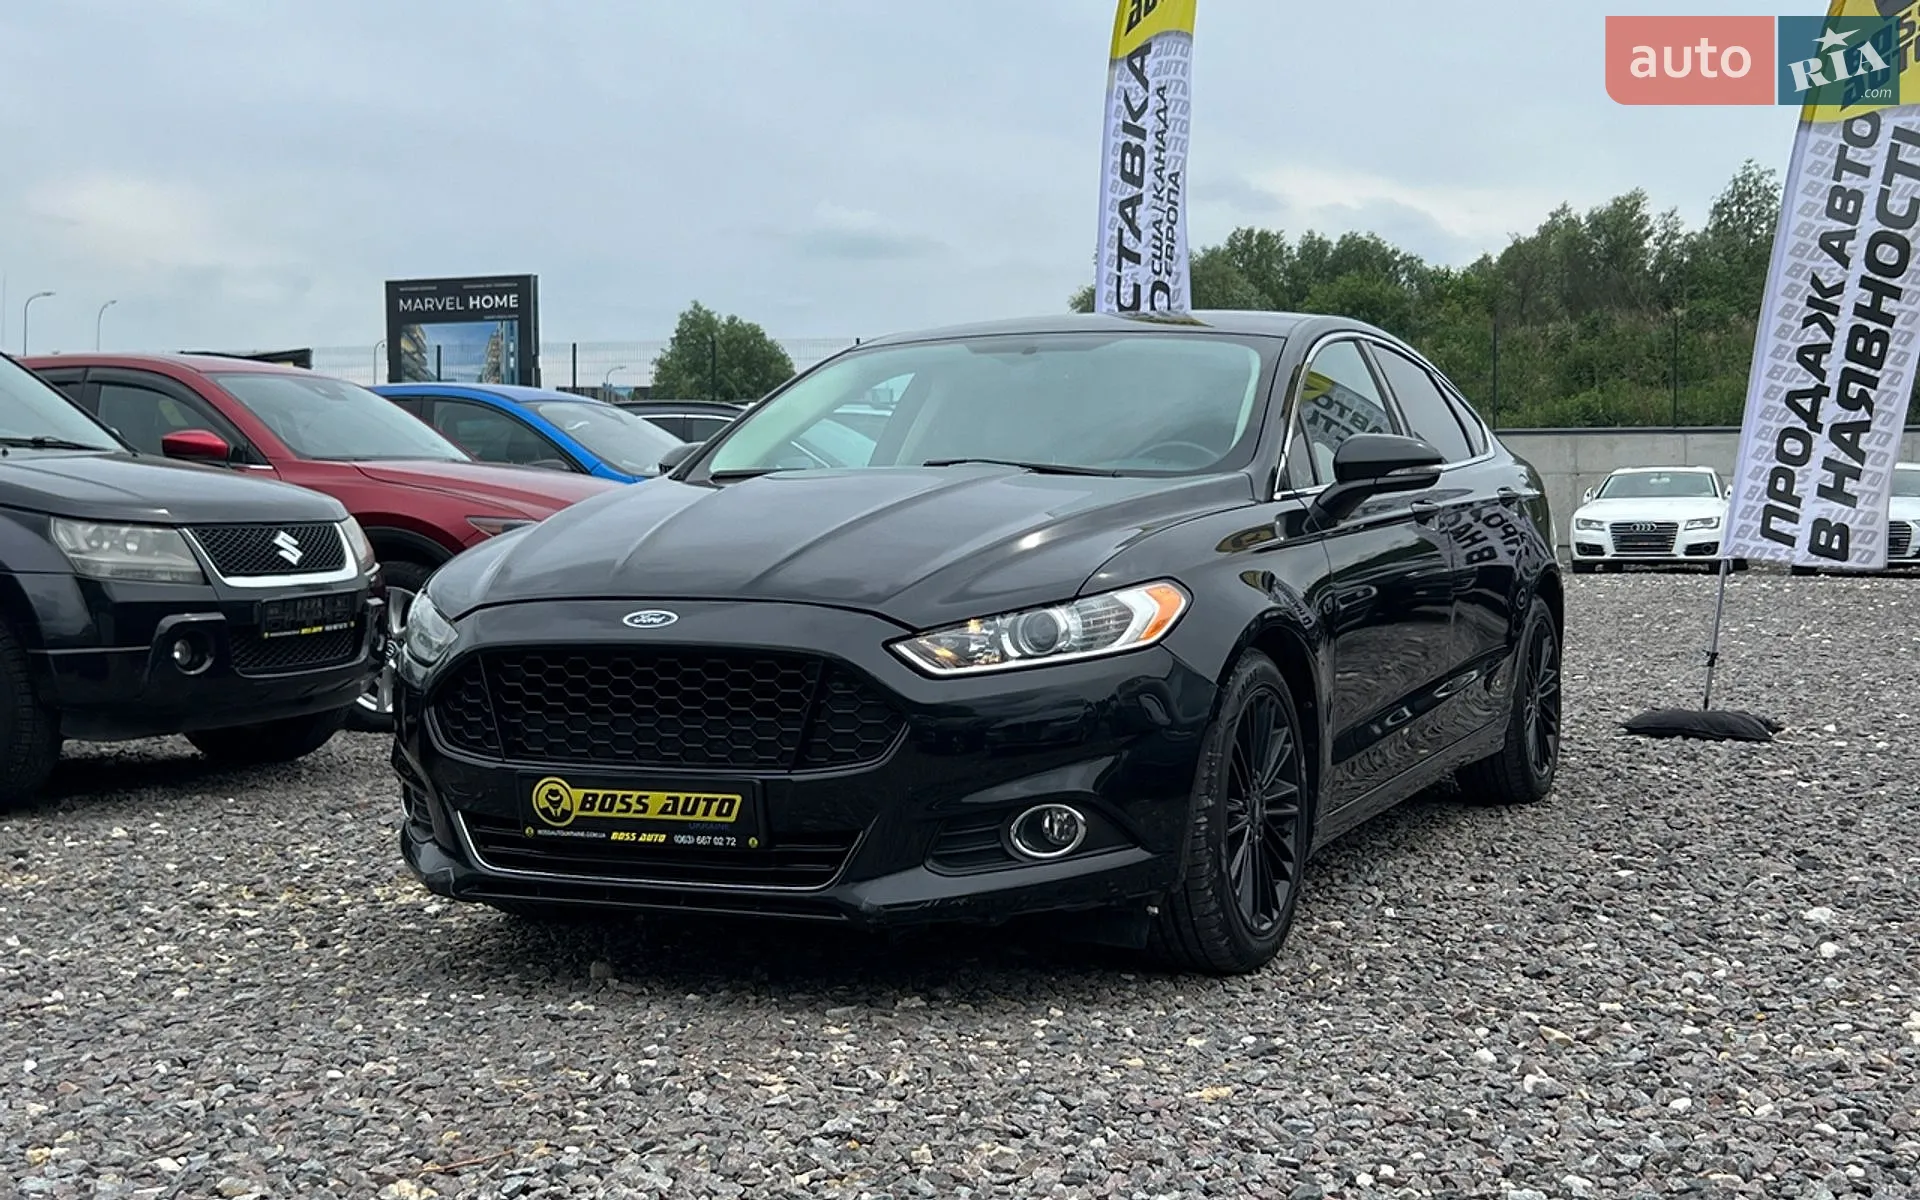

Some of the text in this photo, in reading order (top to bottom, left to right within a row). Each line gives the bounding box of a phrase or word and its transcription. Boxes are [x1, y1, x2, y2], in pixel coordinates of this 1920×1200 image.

[1153, 84, 1169, 203] КАНАДА
[399, 294, 519, 313] MARVEL HOME
[1760, 111, 1881, 548] ПРОДАЖ АВТО
[1807, 517, 1850, 562] В
[579, 792, 737, 818] BOSS AUTO
[610, 832, 637, 842] BOSS
[638, 833, 667, 843] AUTO
[725, 836, 737, 847] 72
